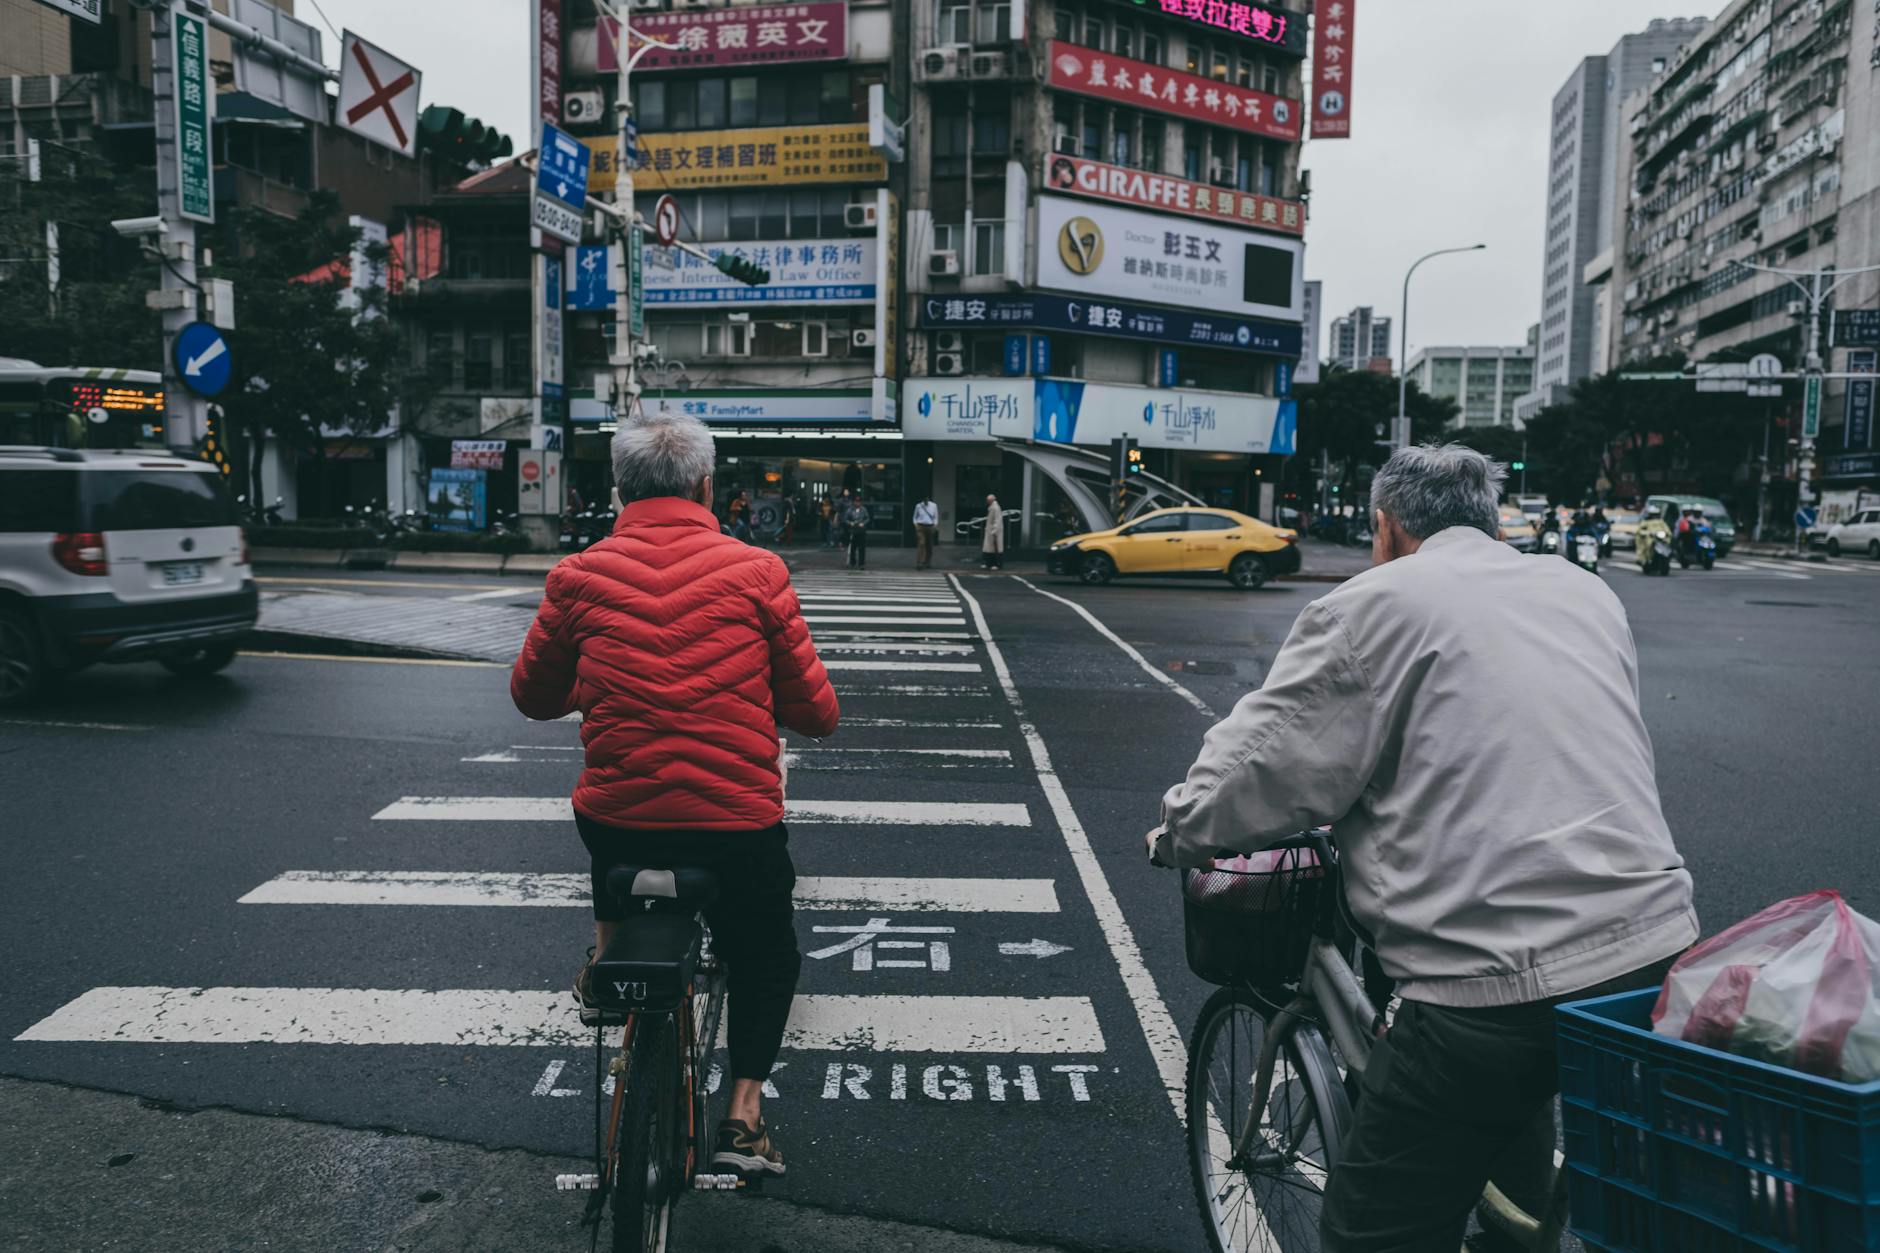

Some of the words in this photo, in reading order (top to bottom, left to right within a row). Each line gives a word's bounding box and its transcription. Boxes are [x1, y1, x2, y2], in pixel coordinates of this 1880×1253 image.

[678, 19, 829, 51] 徐薇英文
[1077, 164, 1190, 209] GIRAFFE
[780, 269, 807, 282] Law
[817, 266, 862, 281] Office
[945, 299, 986, 320] 捷安
[1088, 306, 1122, 328] 捷安
[683, 401, 707, 414] 全家
[711, 405, 763, 416] FamilyMart
[613, 982, 647, 1000] YU
[821, 1063, 1099, 1102] RIGHT
